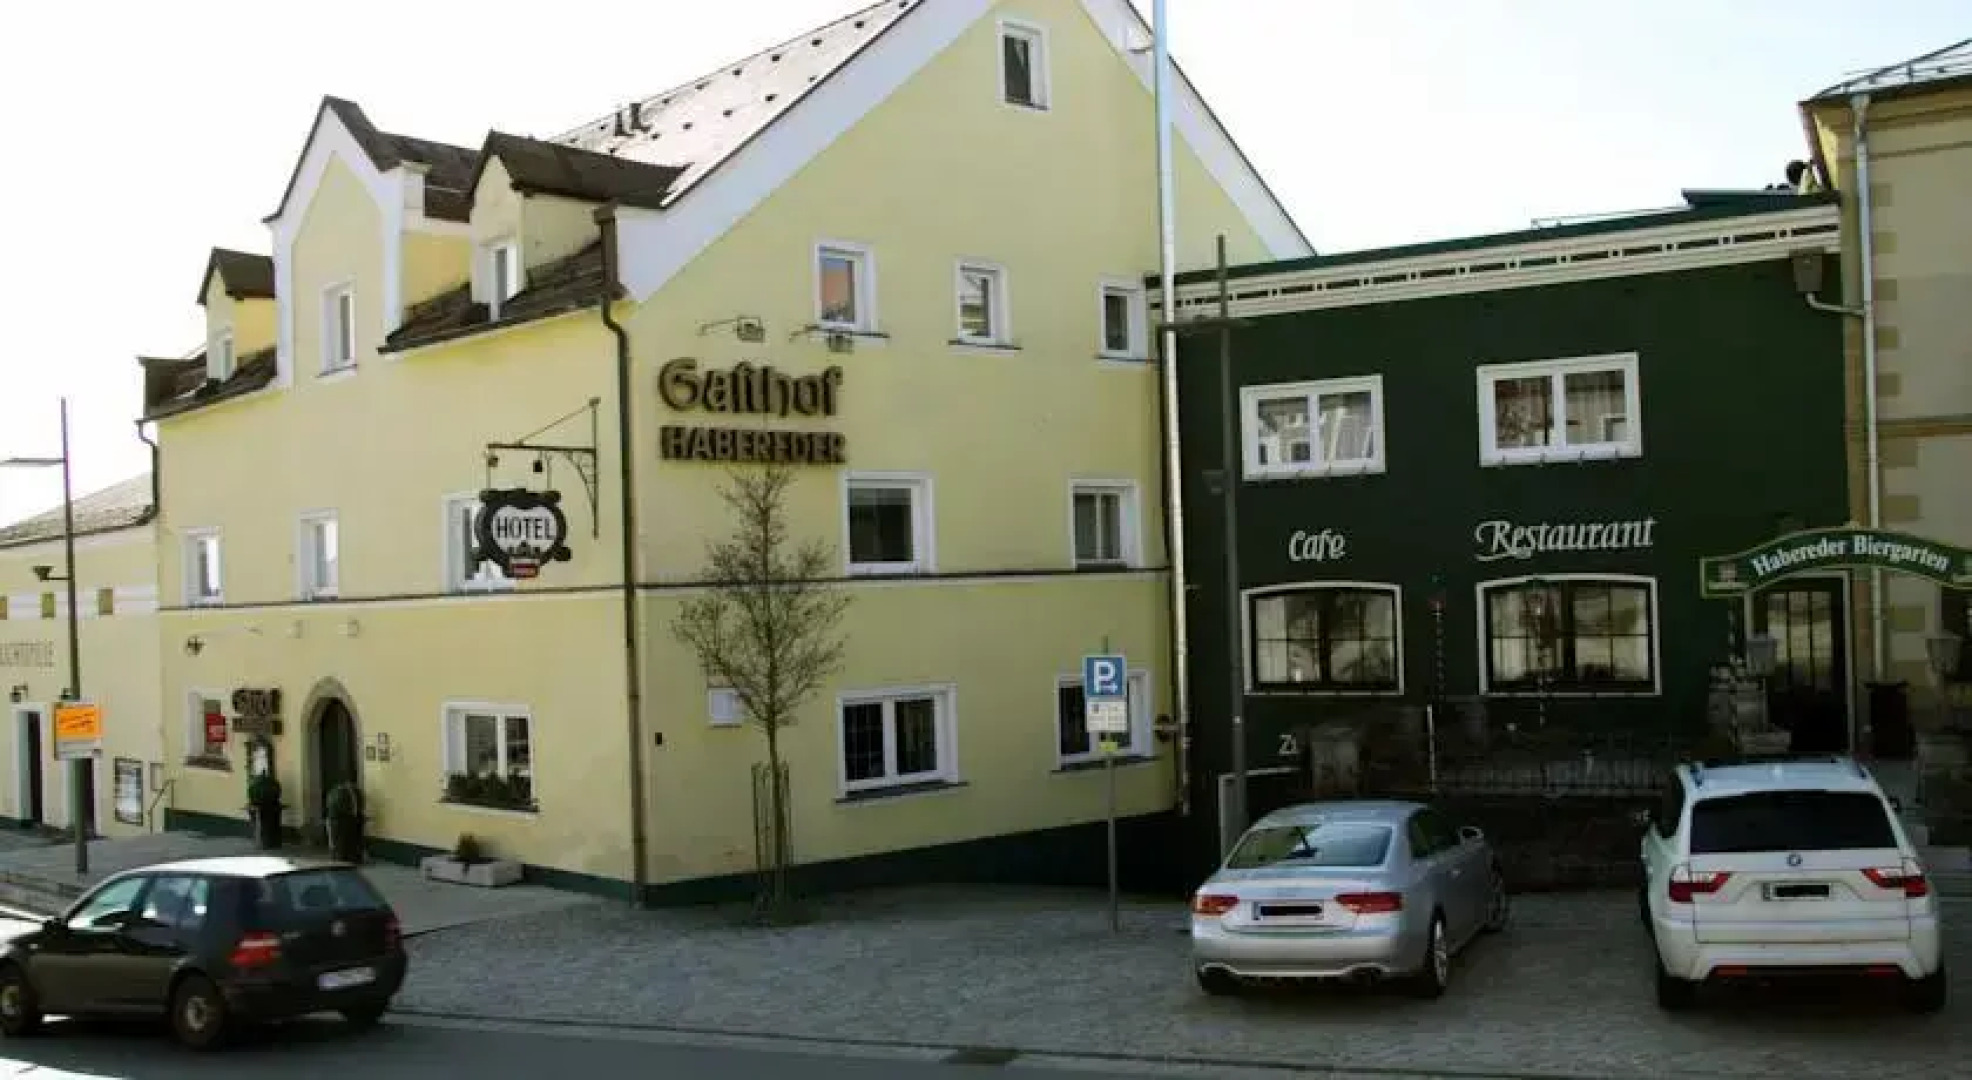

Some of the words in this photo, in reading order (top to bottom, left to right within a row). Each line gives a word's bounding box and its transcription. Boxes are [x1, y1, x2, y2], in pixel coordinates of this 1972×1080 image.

[660, 426, 846, 464] HABEREDER
[497, 517, 555, 540] HOTEL
[1289, 528, 1346, 561] Cafe
[1475, 516, 1656, 561] Restaurant
[1752, 538, 1847, 576] Habereder
[1853, 534, 1949, 572] Biergarten
[1093, 661, 1115, 694] P
